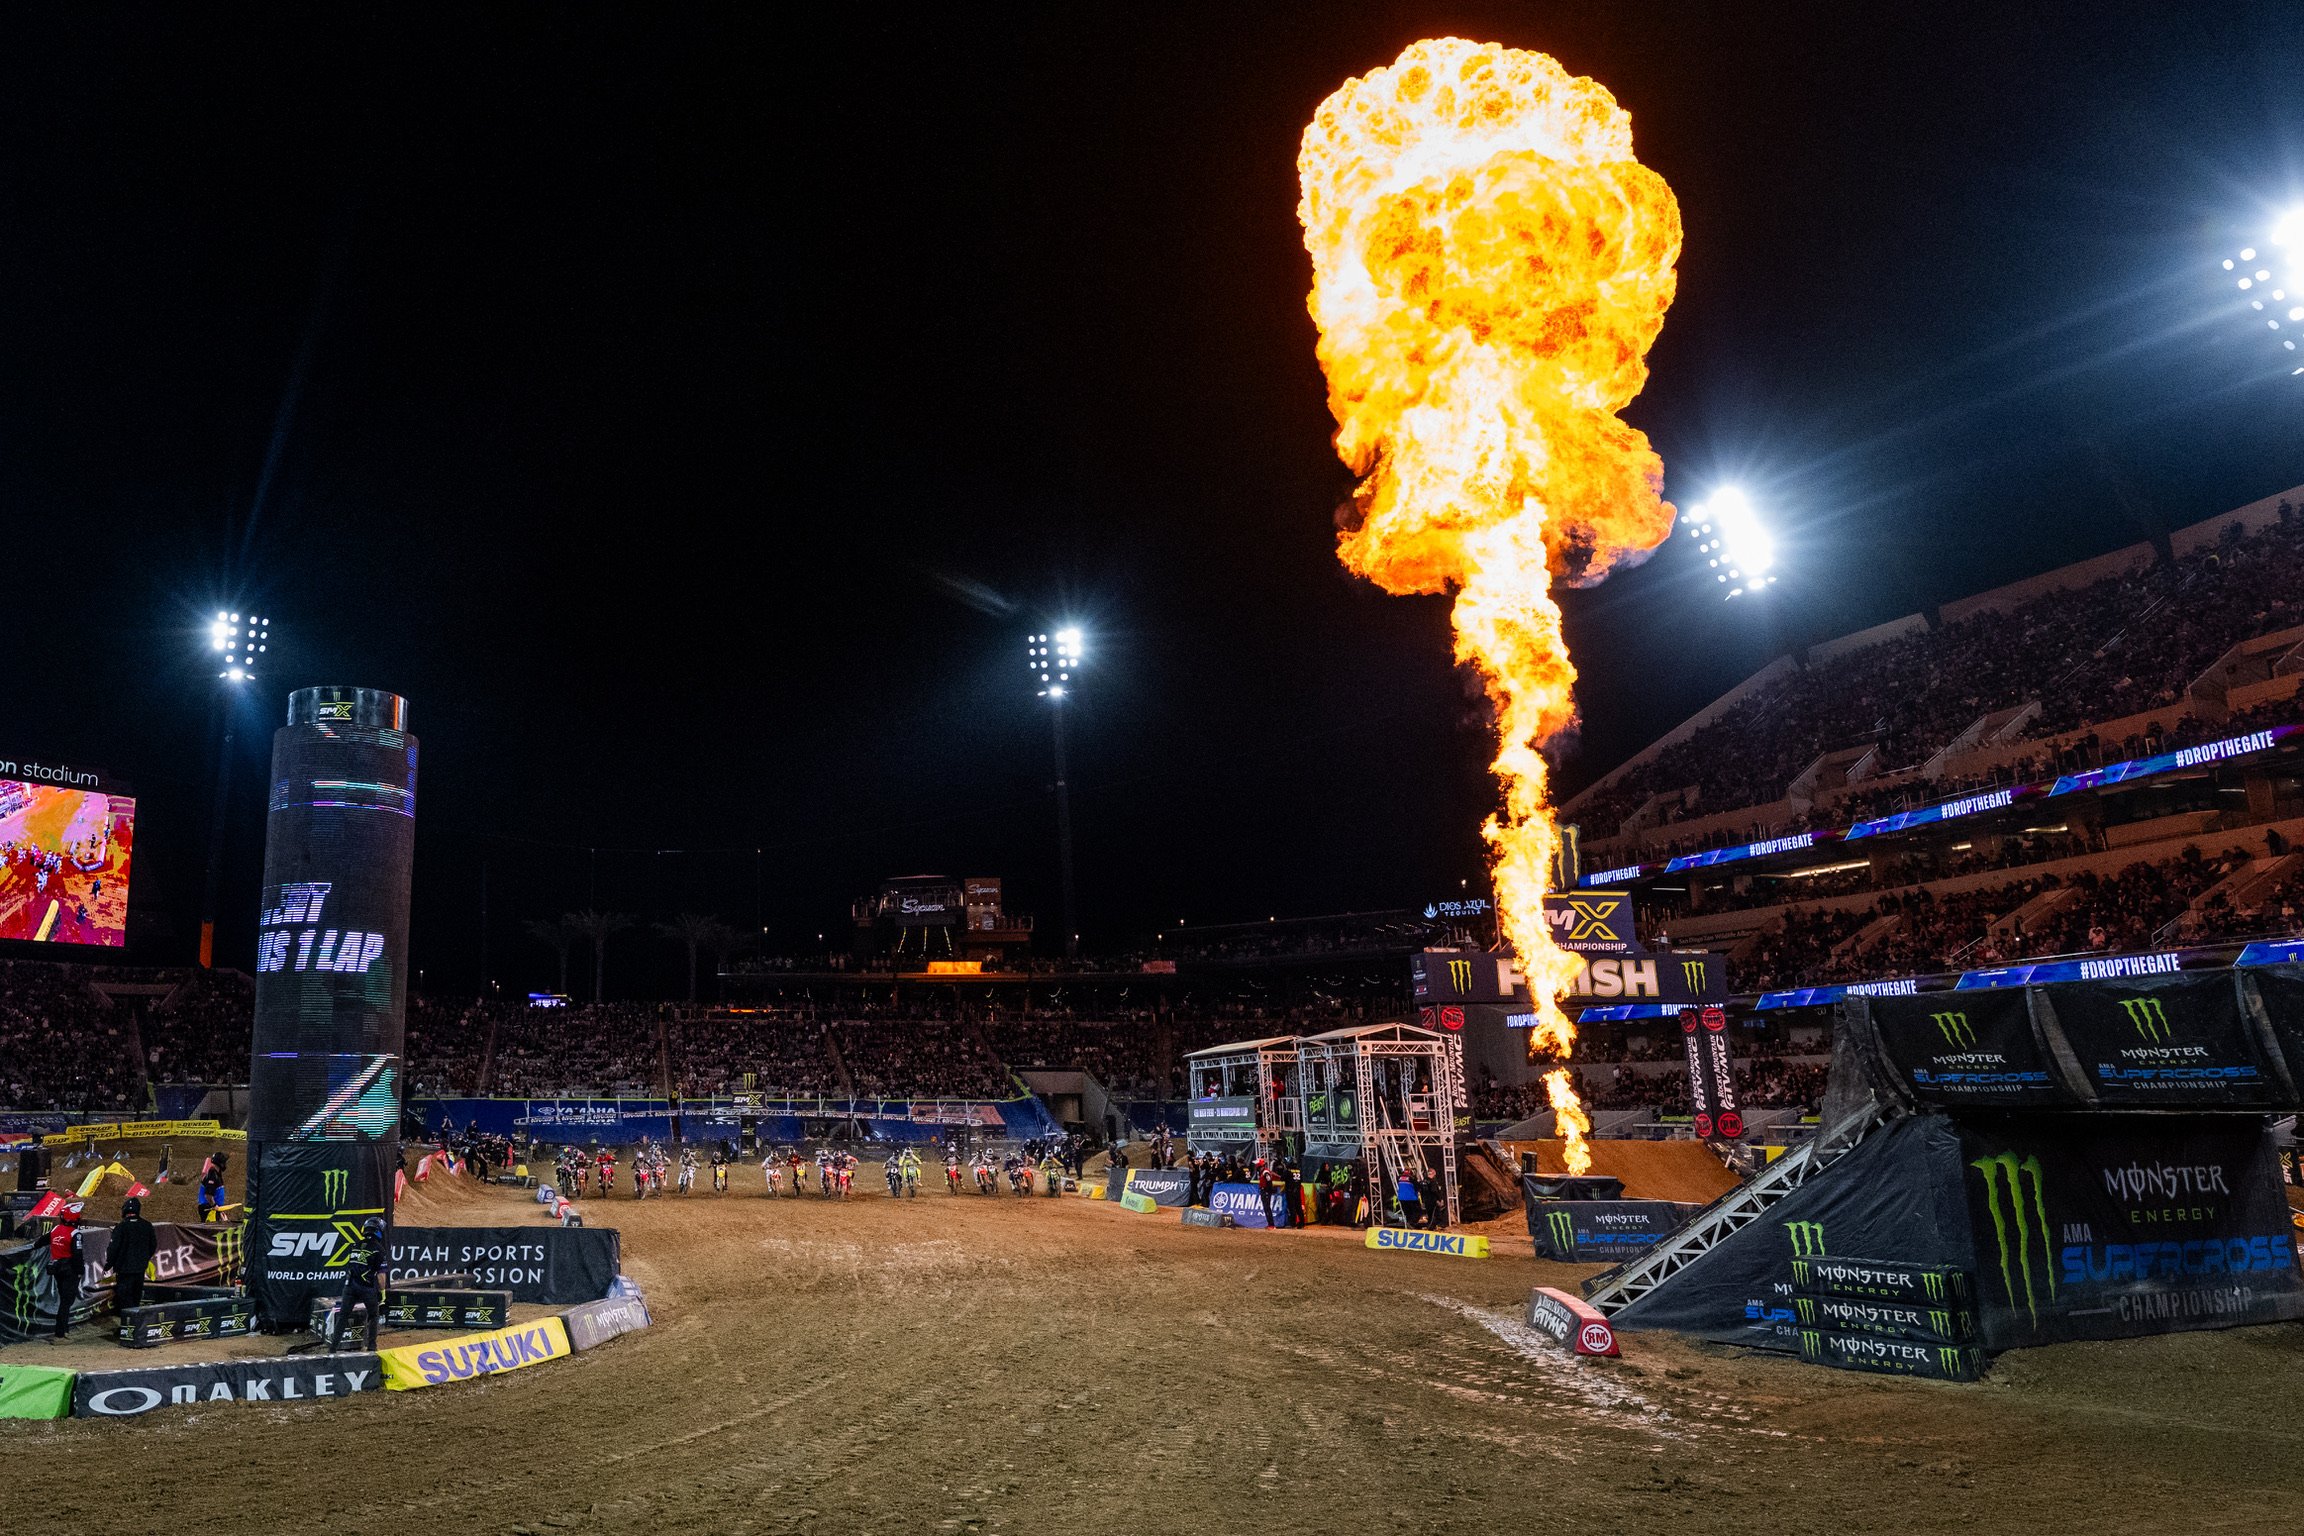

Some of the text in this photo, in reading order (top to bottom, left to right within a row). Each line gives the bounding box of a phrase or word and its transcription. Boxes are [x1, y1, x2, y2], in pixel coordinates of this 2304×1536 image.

[2175, 730, 2275, 768] #DROPTHEGATE
[22, 762, 99, 787] stadium
[1941, 790, 2013, 819] #DROPTHEGATE
[1749, 833, 1813, 857] #DROPTHEGATE
[1590, 865, 1640, 886] #DROPTHEGATE
[901, 898, 945, 916] Sycuan
[1439, 902, 1461, 911] DIOS
[1445, 909, 1481, 917] TEQUILA
[1544, 901, 1620, 940] MX
[316, 929, 384, 972] LAP
[2080, 953, 2181, 980] #DROPTHEGATE
[1496, 958, 1660, 997] FISH
[1932, 1053, 2007, 1065] MONSTER
[2120, 1046, 2209, 1059] MONSTER
[1914, 1071, 2048, 1084] SUPERCROSS
[2098, 1066, 2257, 1080] SUPERCROSS
[1943, 1084, 2023, 1093] CHAMPIONSHIP
[2133, 1080, 2228, 1090] CHAMPIONSHIP
[1454, 1116, 1471, 1127] EAST
[1134, 1180, 1178, 1194] TRIUMPH
[2104, 1160, 2230, 1201] MONSTER
[1595, 1213, 1650, 1225] MONSTER
[2131, 1207, 2216, 1223] ENERGY
[2063, 1224, 2093, 1243] AMA
[1377, 1230, 1465, 1254] SUZUKI
[391, 1245, 545, 1262] UTAH SPORTS
[2061, 1235, 2292, 1284] SUPERCROSS
[267, 1270, 303, 1280] WORLD
[1817, 1265, 1914, 1288] MONSTER
[1834, 1283, 1900, 1296] ENERGY
[1747, 1298, 1764, 1307] AMA
[2119, 1286, 2252, 1322] CHAMPIONSHIP
[389, 1308, 416, 1320] SMX
[426, 1308, 455, 1320] SMX
[465, 1309, 493, 1322] SMX
[1823, 1303, 1921, 1325] MONSTER
[184, 1320, 211, 1333] SMX
[220, 1316, 246, 1329] SMX
[1840, 1321, 1908, 1334] ENERGY
[147, 1324, 174, 1338] SMX
[342, 1328, 363, 1340] MX
[1829, 1336, 1930, 1362] MONSTER
[417, 1328, 554, 1385] SUZUKI
[1847, 1356, 1915, 1370] ENERGY
[171, 1369, 369, 1403] OAKLEY
